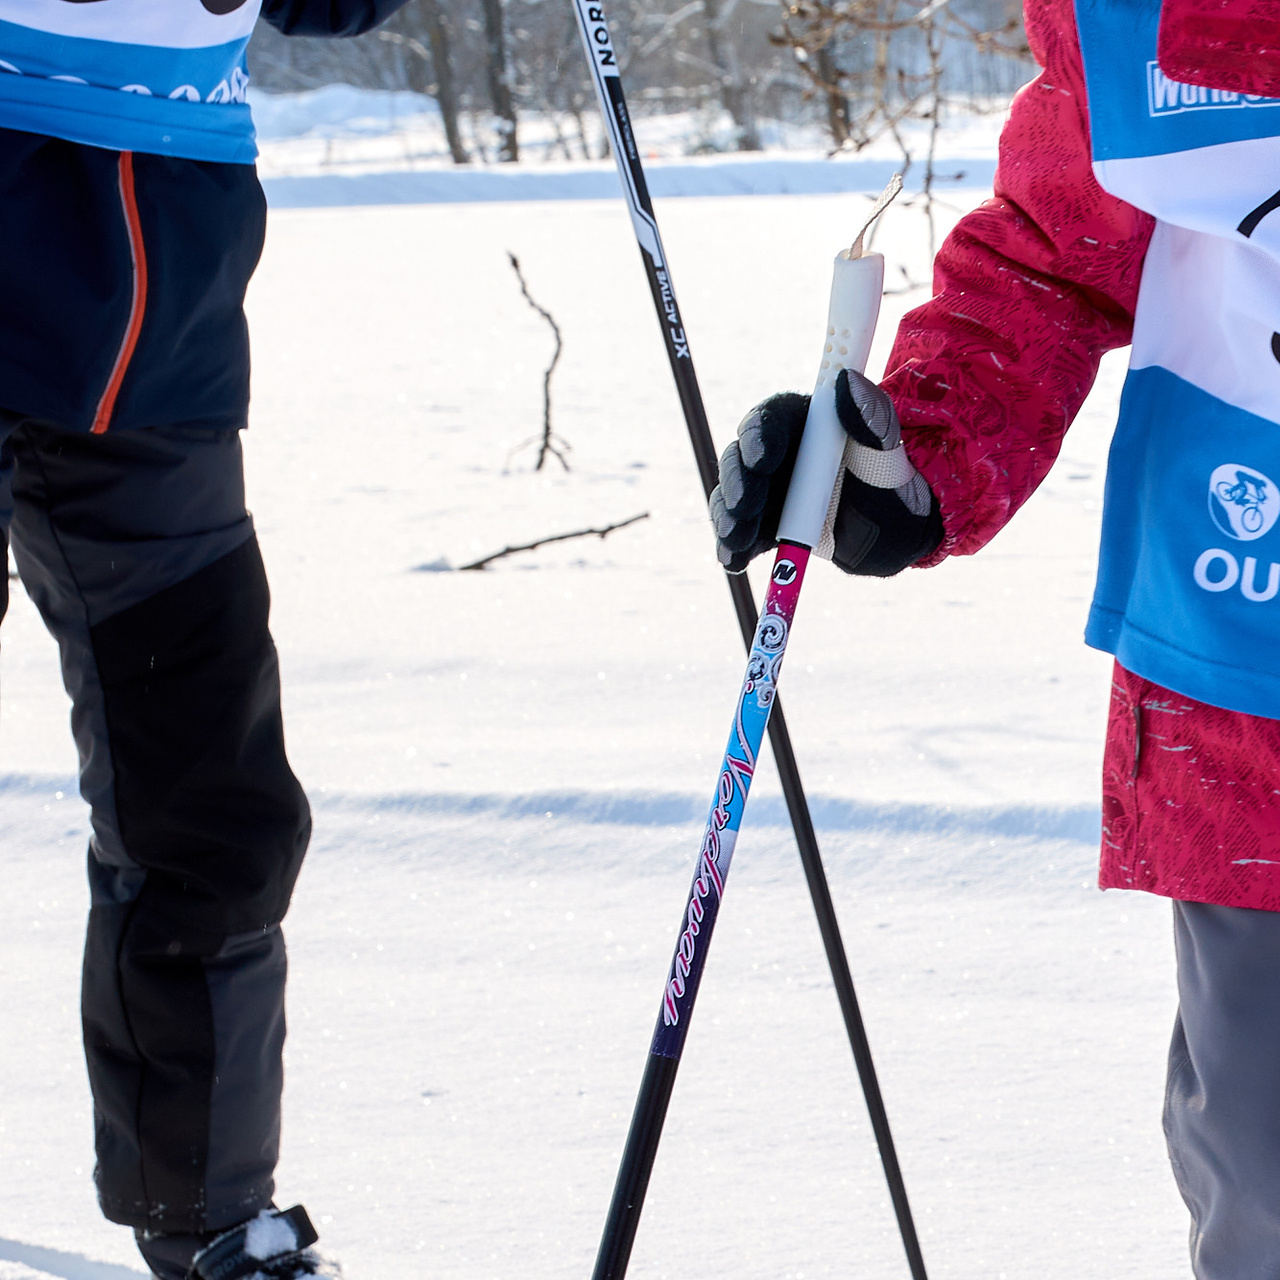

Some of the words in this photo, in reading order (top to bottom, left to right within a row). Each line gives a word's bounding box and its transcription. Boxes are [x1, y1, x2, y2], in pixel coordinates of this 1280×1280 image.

[656, 270, 677, 324] ACTIVE
[671, 328, 689, 358] XC
[664, 681, 755, 1027] Nordway
